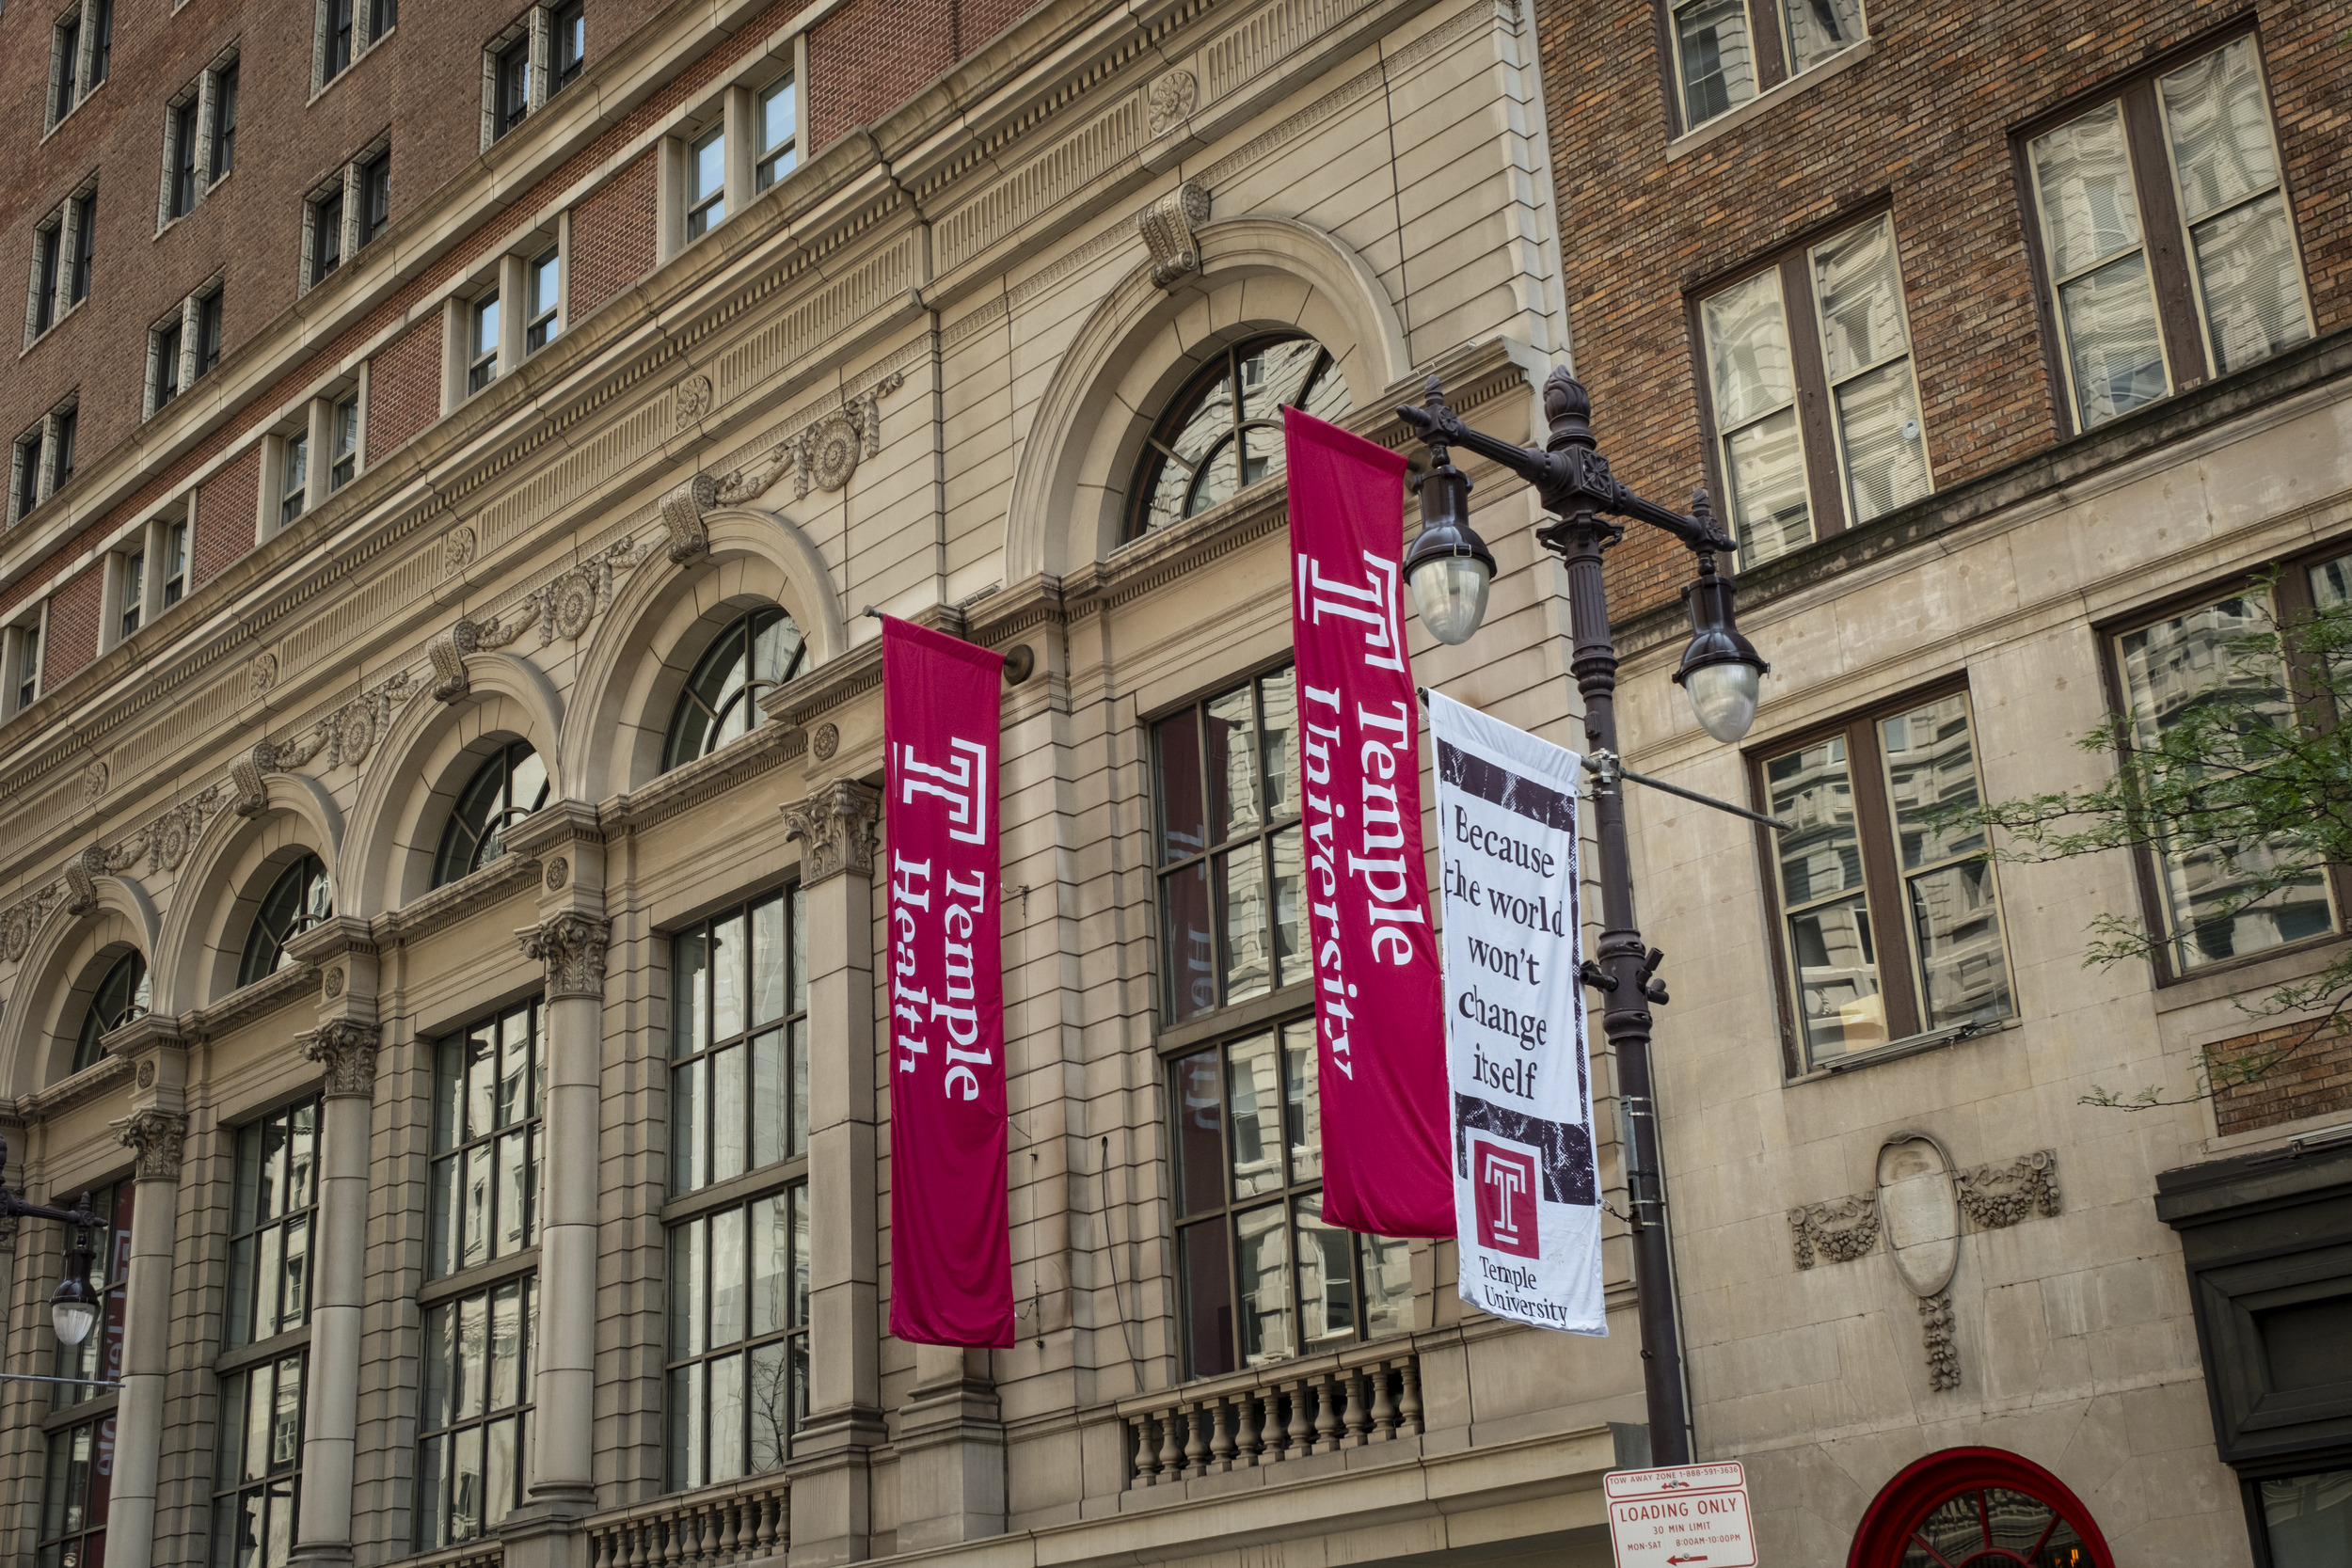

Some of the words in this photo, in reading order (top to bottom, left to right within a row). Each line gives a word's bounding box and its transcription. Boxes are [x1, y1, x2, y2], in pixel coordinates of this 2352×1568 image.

[1347, 700, 1425, 966] Temple
[1454, 804, 1555, 879] Because
[1304, 685, 1358, 1081] University
[1444, 859, 1482, 907] the
[1487, 888, 1565, 938] world
[894, 847, 930, 1073] Health
[930, 869, 992, 1101] Temple
[1468, 935, 1540, 986] won't
[1458, 984, 1547, 1051] change
[1472, 1042, 1537, 1100] itself
[1479, 1255, 1537, 1292] Temple
[1484, 1284, 1568, 1326] University
[1610, 1476, 1628, 1485] TOW
[1630, 1474, 1653, 1483] AWAY
[1656, 1471, 1677, 1481] ZONE
[1679, 1466, 1739, 1478] 1-888-591-3636
[1620, 1502, 1689, 1523] LOADING
[1697, 1497, 1737, 1515] ONLY
[1653, 1526, 1664, 1535] 30
[1669, 1524, 1685, 1533] MIN
[1689, 1522, 1711, 1531] LIMIT
[1628, 1541, 1661, 1551] MON-SAT
